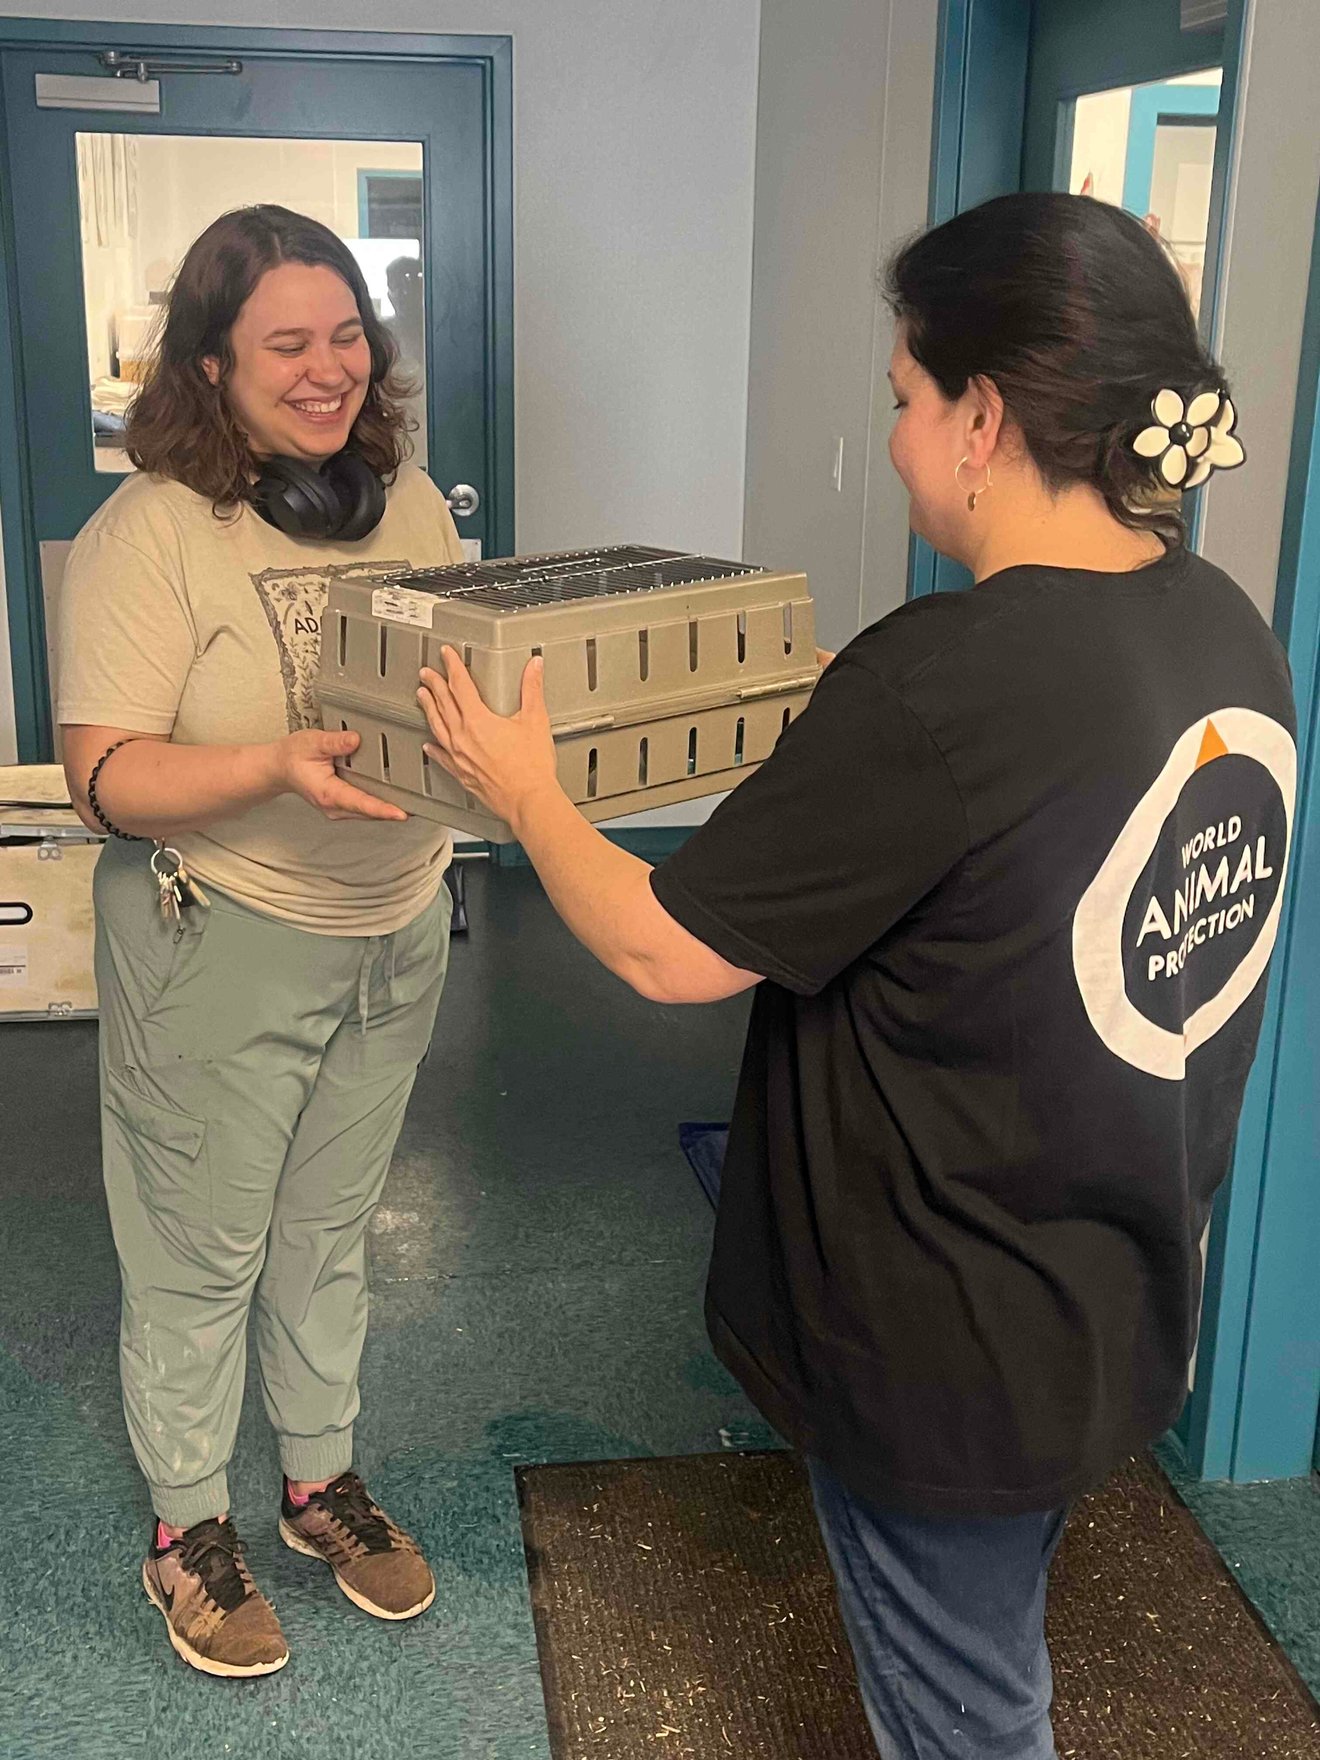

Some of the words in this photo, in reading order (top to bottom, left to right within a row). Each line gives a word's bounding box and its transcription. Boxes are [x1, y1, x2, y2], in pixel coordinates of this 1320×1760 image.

[294, 617, 322, 635] AD
[1181, 815, 1242, 869] WORLD
[1136, 835, 1273, 948] ANIMAL
